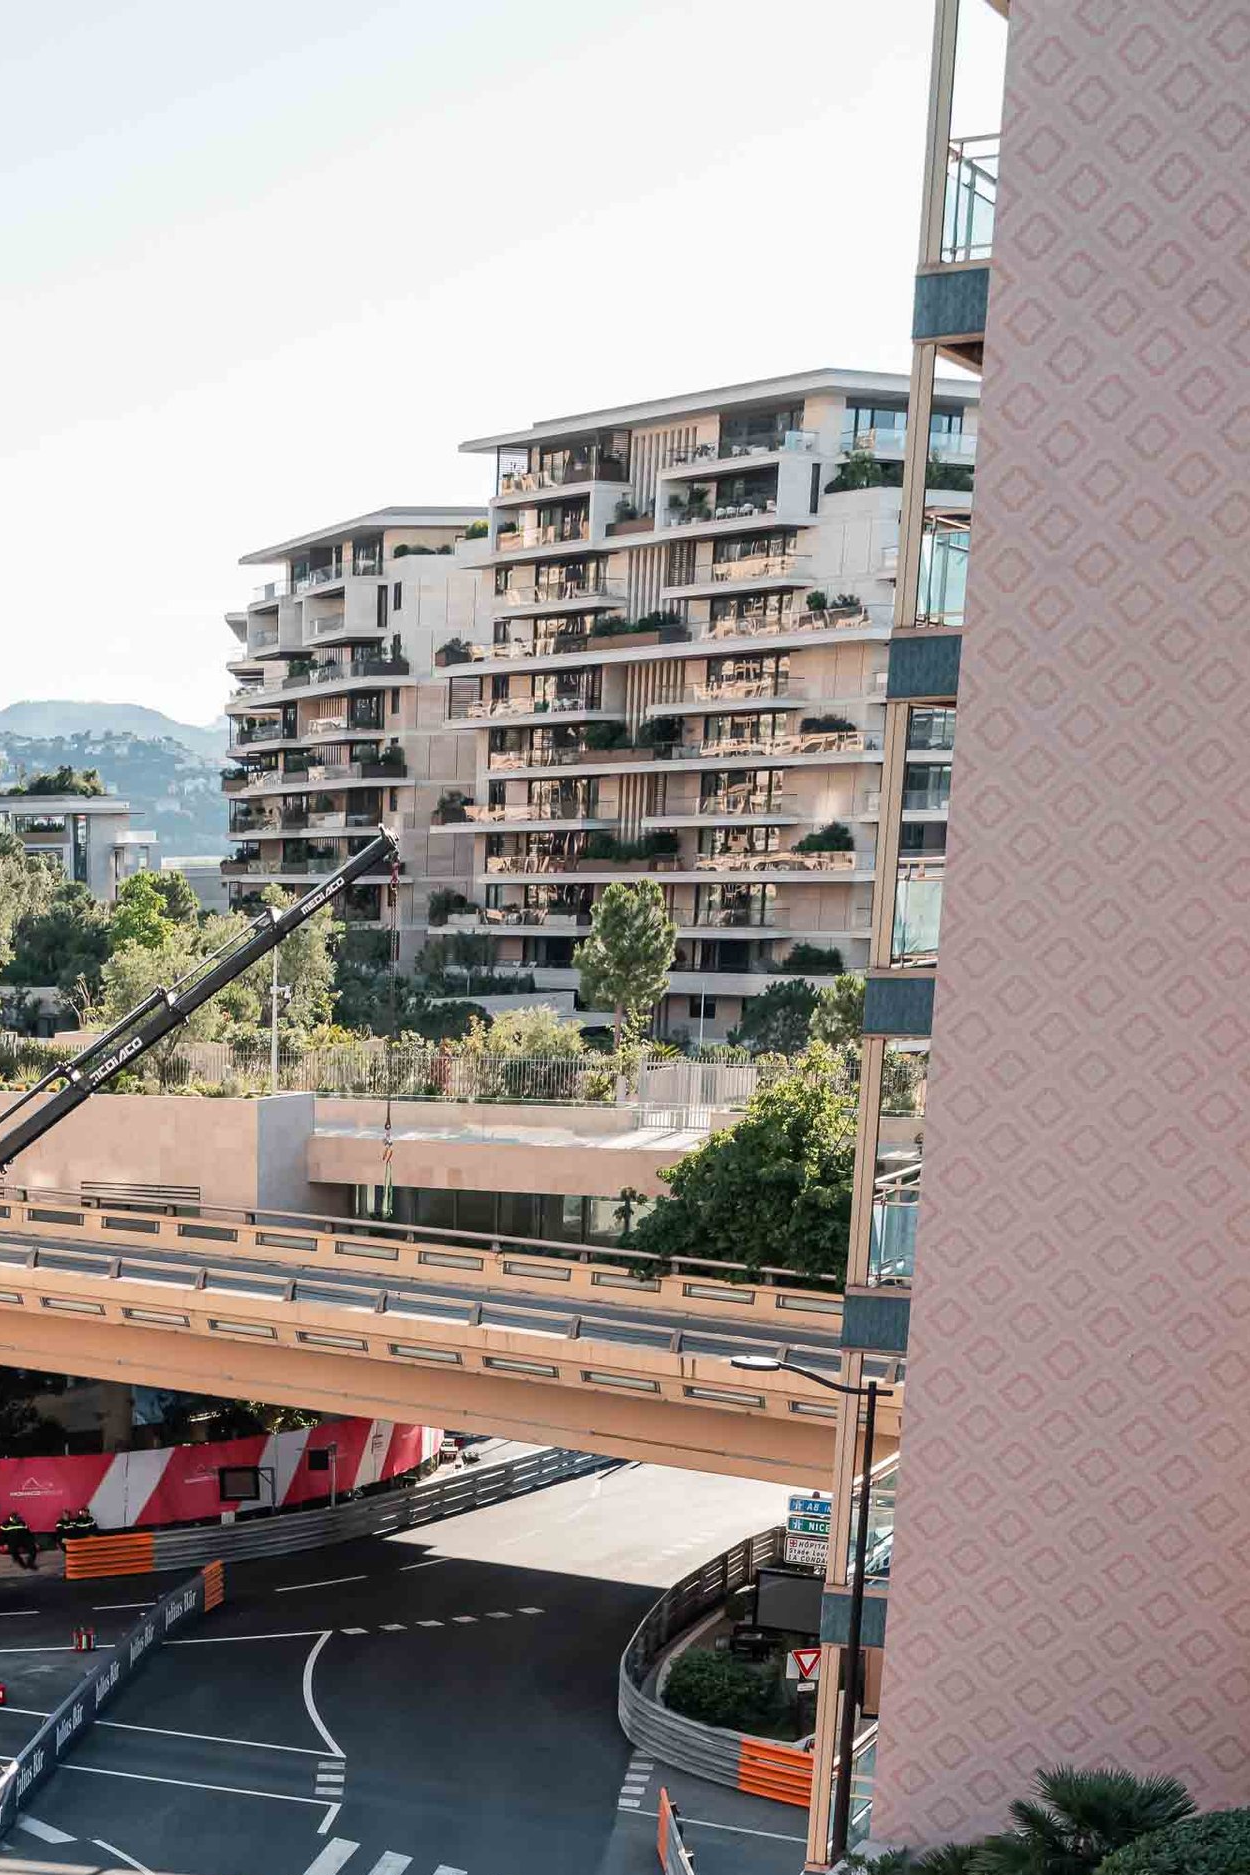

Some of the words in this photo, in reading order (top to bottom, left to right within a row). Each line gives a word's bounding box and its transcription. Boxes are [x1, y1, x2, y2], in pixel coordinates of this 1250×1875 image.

[808, 1522, 830, 1533] NICE
[812, 1550, 828, 1558] Loui
[800, 1556, 828, 1564] CONDA
